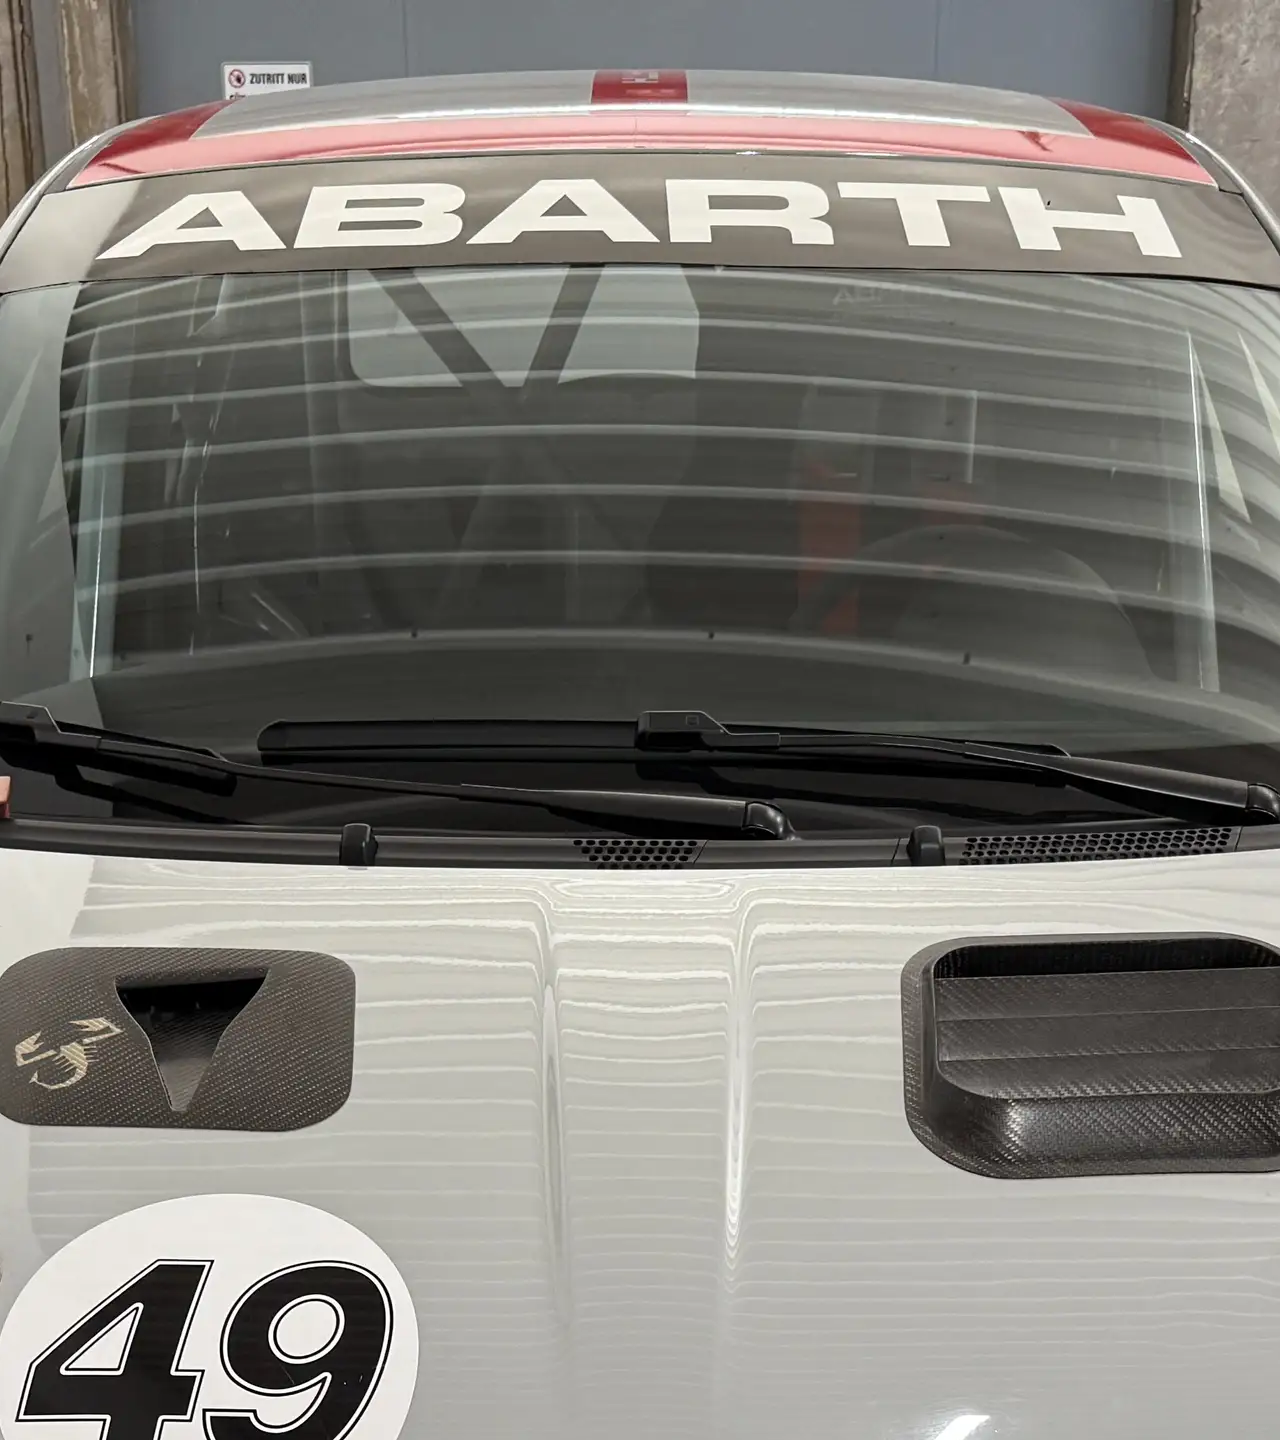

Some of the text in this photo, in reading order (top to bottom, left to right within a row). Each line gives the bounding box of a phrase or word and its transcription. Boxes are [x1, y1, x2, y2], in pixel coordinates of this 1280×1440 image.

[249, 73, 307, 85] ZUTRITT NUR
[95, 179, 1182, 260] ABARTH
